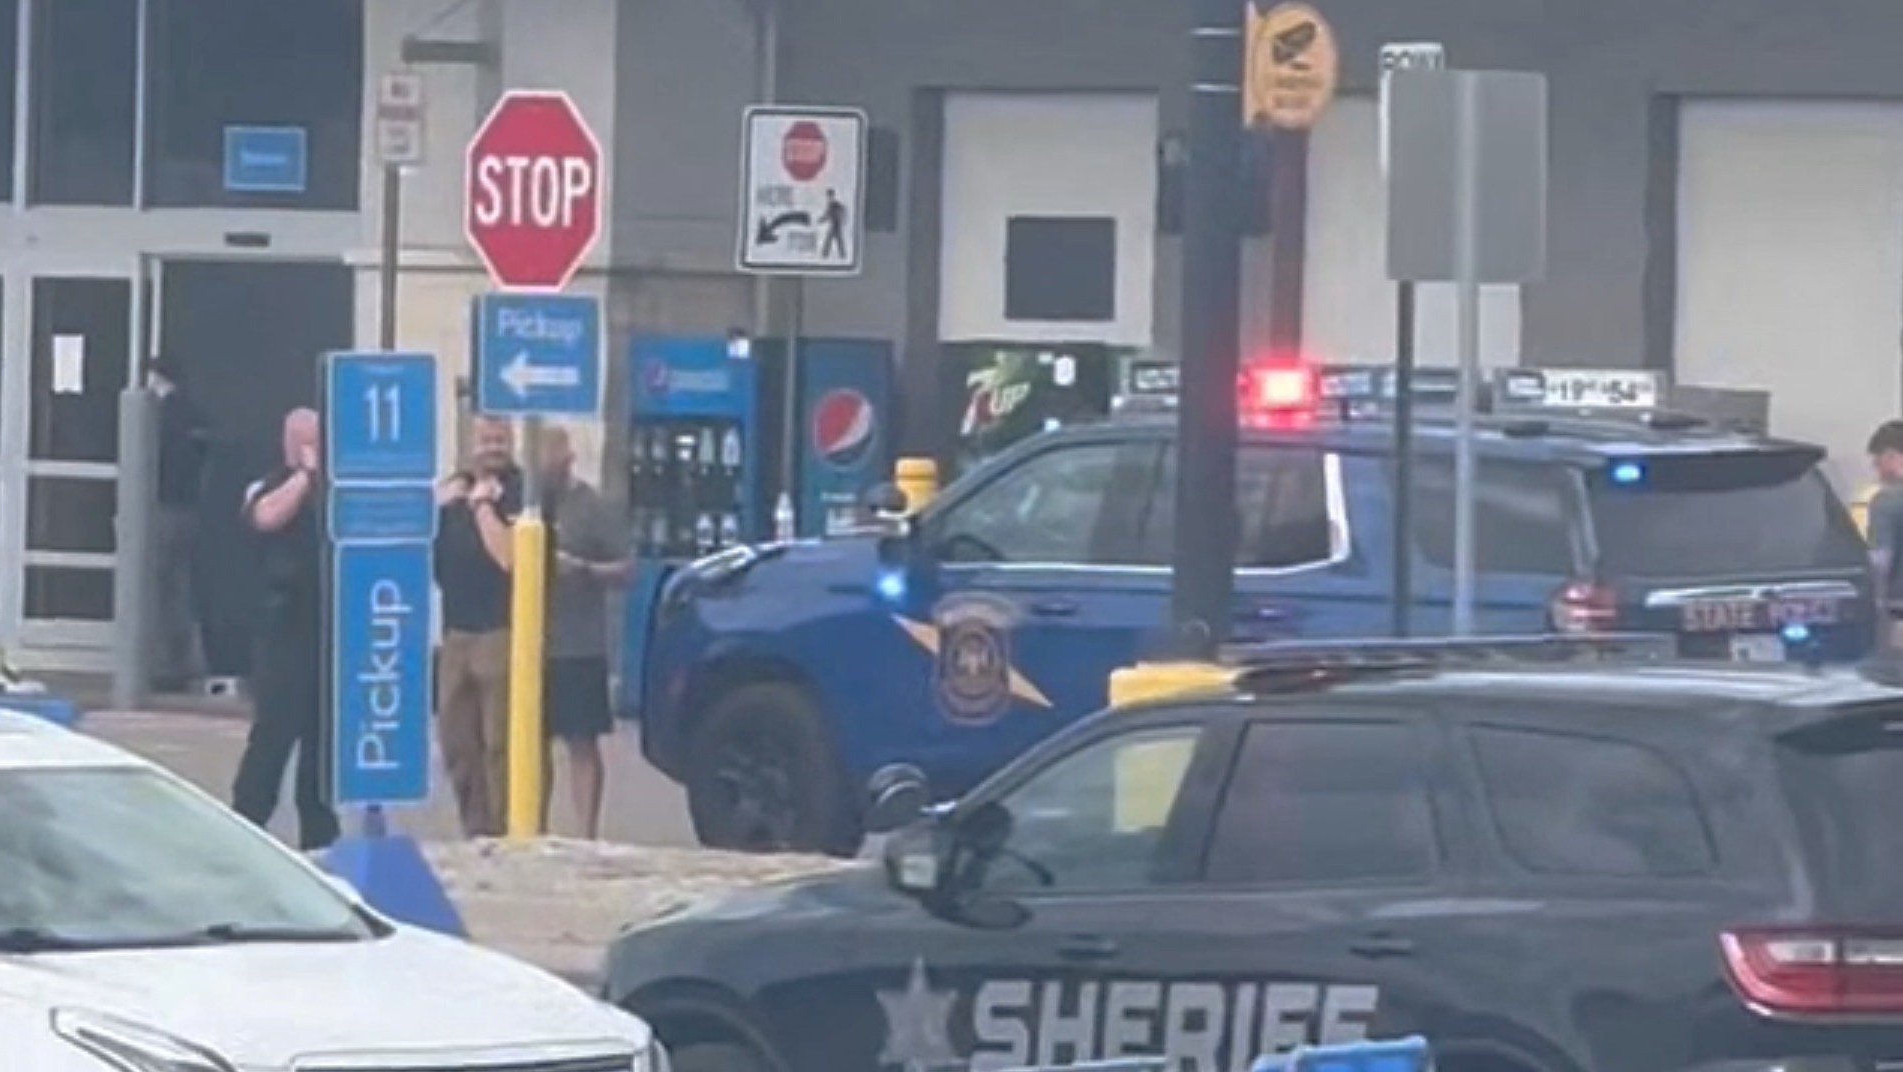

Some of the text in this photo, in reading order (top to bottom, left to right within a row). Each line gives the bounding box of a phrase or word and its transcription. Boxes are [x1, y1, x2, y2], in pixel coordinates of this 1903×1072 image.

[476, 154, 591, 228] STOP
[498, 308, 584, 346] Pickup
[363, 384, 401, 443] 11
[355, 578, 414, 771] Pickup
[972, 980, 1379, 1072] SHERIFF
